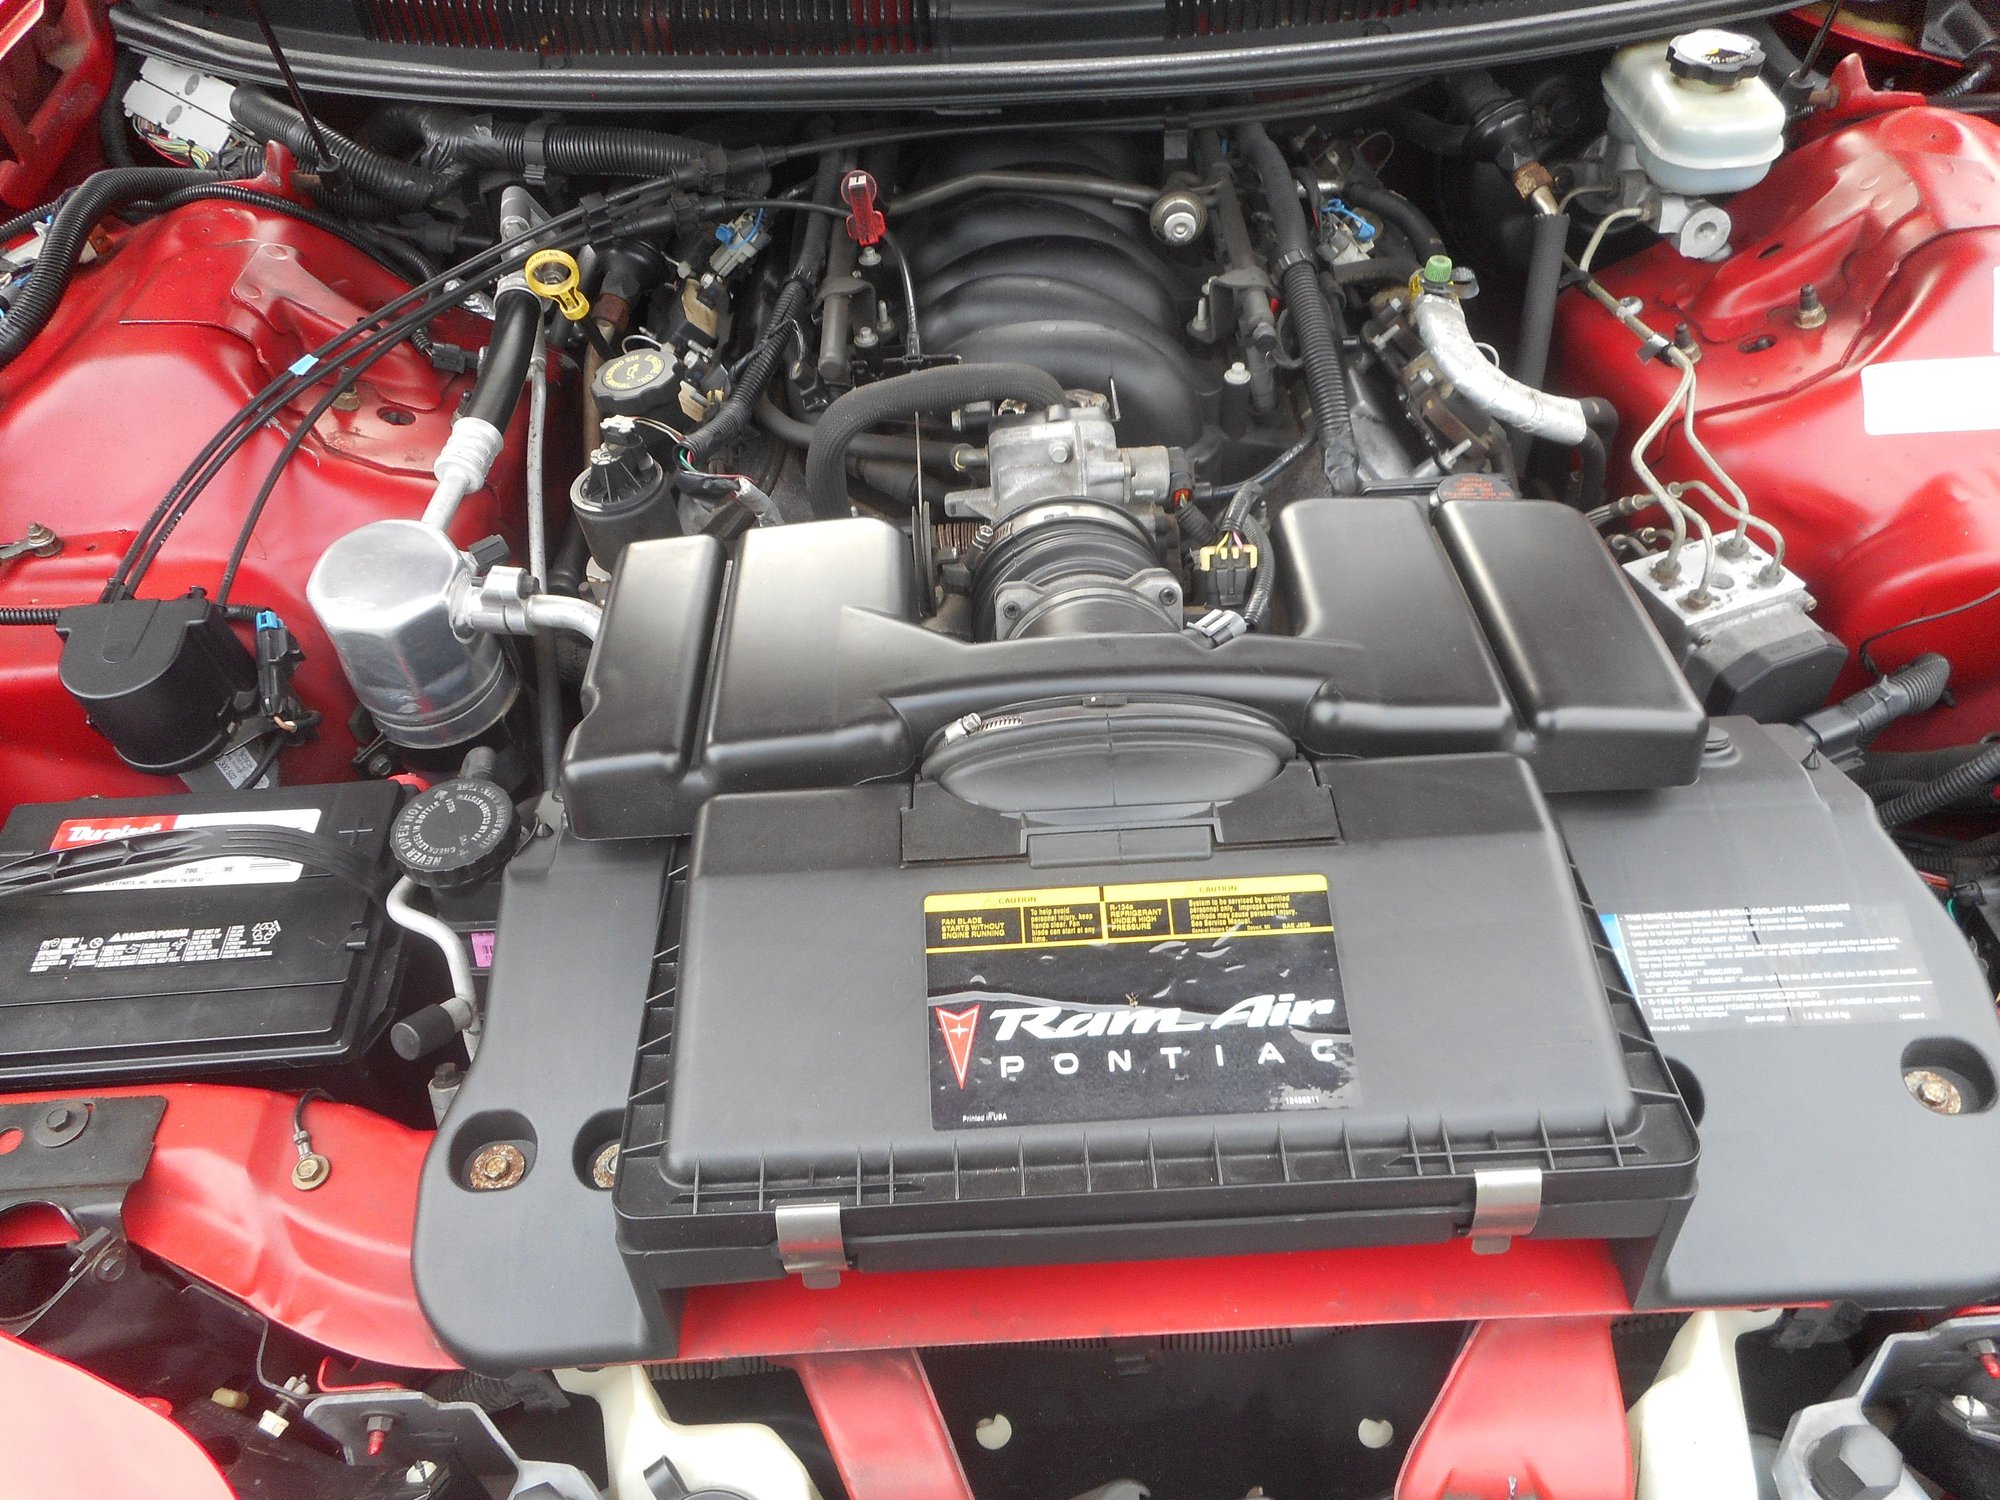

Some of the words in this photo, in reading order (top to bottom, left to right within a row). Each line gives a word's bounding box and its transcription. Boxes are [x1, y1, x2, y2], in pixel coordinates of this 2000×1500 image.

[404, 802, 423, 822] HOT
[398, 824, 412, 850] OPEN
[412, 832, 429, 851] LEVEL
[405, 848, 442, 866] NEVER
[998, 896, 1037, 905] CAUTION
[1053, 907, 1070, 915] avoid
[1110, 908, 1163, 918] REFRIGERANT
[1642, 912, 1673, 921] VEHICLE
[1673, 910, 1712, 919] REQUIRES
[1750, 906, 1786, 915] COOLANT
[1787, 906, 1804, 914] FILL
[1804, 903, 1851, 912] PROCEDURE
[941, 918, 956, 926] FAN
[1078, 913, 1094, 921] keep
[1111, 916, 1137, 925] UNDER
[1138, 915, 1157, 923] HIGH
[941, 924, 970, 933] STARTS
[970, 922, 1005, 931] WITHOUT
[1111, 922, 1152, 932] PRESSURE
[121, 928, 190, 941] DANGER/POISON
[941, 931, 970, 940] ENGINE
[971, 929, 1005, 938] RUNNING
[1631, 939, 1648, 947] USE
[1691, 935, 1727, 945] COOLANT
[1728, 935, 1748, 943] ONLY
[1703, 967, 1743, 976] INDICATOR
[1693, 996, 1707, 1004] AIR
[1707, 994, 1759, 1003] CONDITIONED
[988, 1006, 1205, 1041] Ram
[1210, 993, 1335, 1030] Air
[1000, 1038, 1336, 1078] PONTIAC
[962, 1114, 985, 1123] Printed
[993, 1112, 1008, 1121] USA
